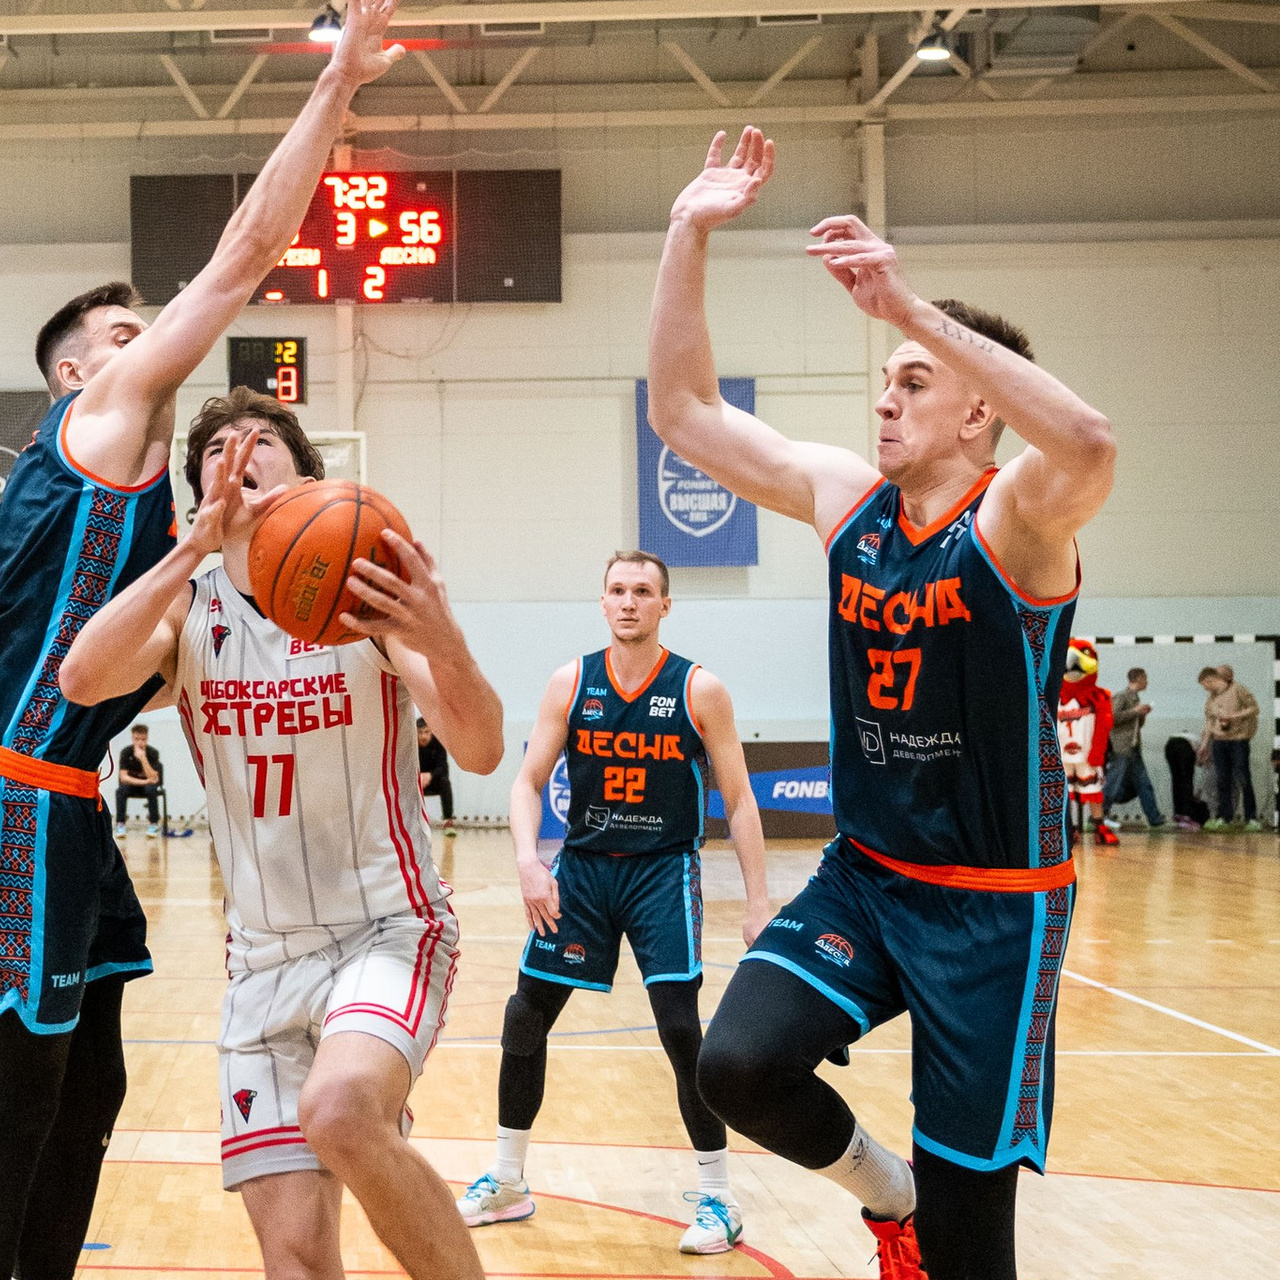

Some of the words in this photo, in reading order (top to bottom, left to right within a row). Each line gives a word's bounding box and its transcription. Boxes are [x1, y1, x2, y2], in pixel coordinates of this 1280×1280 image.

[324, 176, 388, 210] 7:22
[336, 212, 357, 246] 3
[399, 211, 441, 244] 56
[318, 269, 329, 298] 1
[363, 266, 386, 300] 2
[837, 572, 972, 636] ДЕСНА
[586, 686, 607, 697] TEAM
[867, 647, 922, 711] 27
[648, 706, 676, 718] BET
[649, 695, 676, 707] FON
[576, 729, 685, 761] ДЕСНА
[889, 731, 962, 749] НАДЕЖДА
[603, 766, 647, 804] 22
[772, 780, 829, 799] FONB
[611, 812, 663, 825] НАДЕЖДА
[535, 938, 556, 952] TEAM
[51, 971, 81, 988] TEAM
